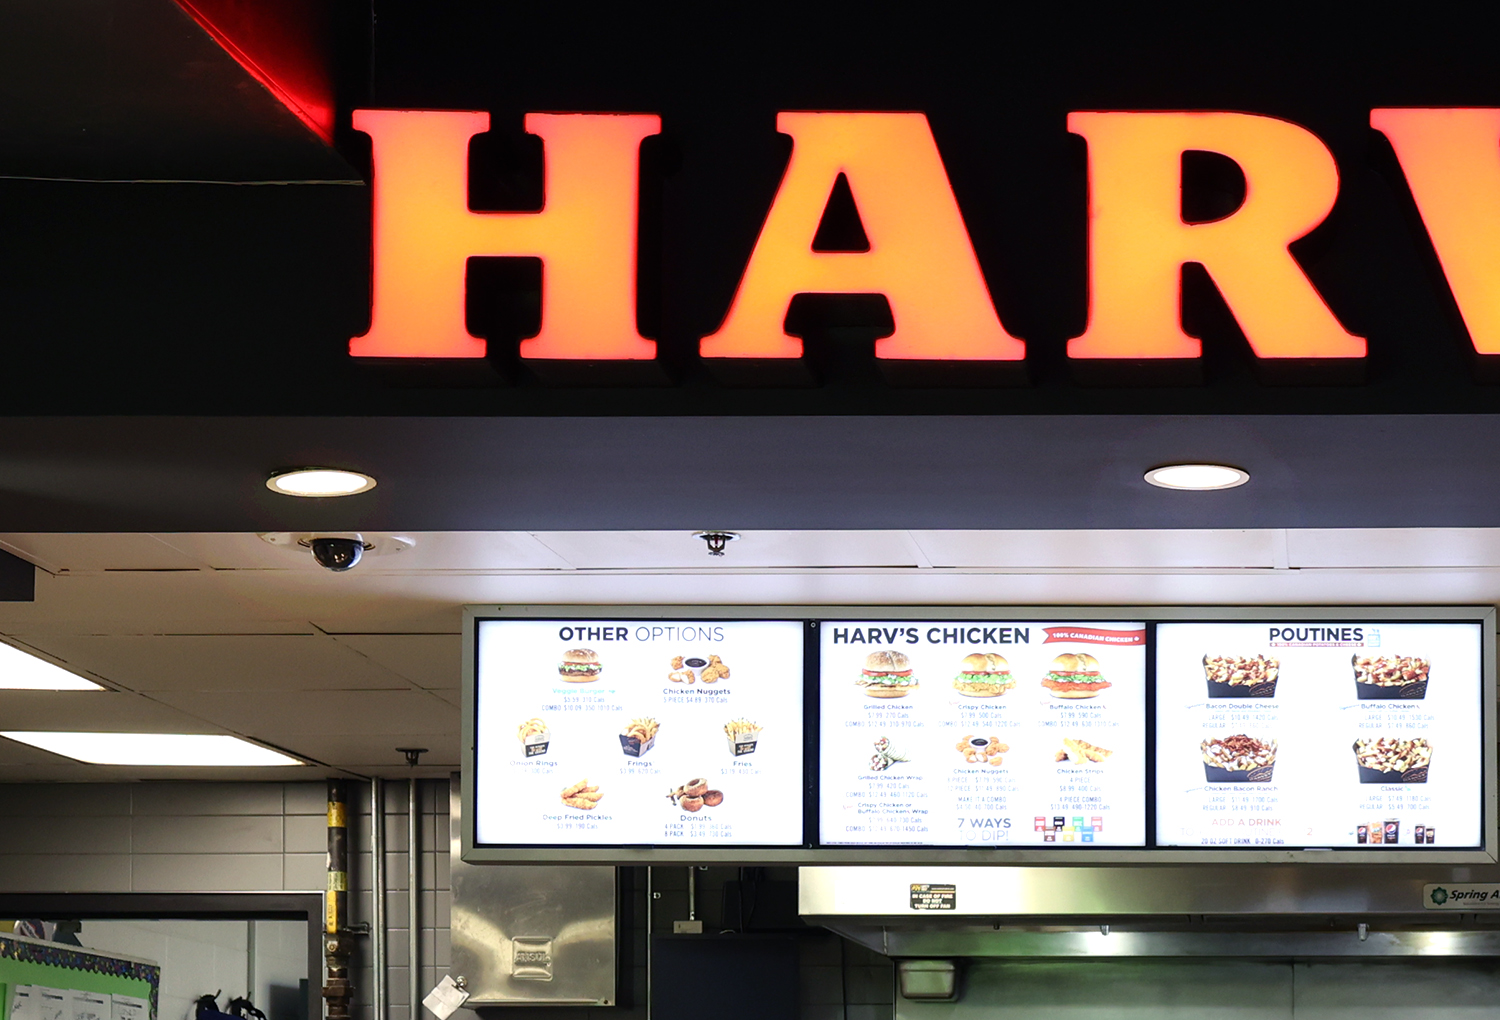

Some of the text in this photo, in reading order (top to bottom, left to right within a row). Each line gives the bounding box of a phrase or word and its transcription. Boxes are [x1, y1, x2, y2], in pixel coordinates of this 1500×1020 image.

[559, 626, 724, 641] OTHER OPTIONS
[833, 627, 1030, 644] HARV'S CHICKEN
[1070, 633, 1104, 642] CANADIAN
[1269, 628, 1363, 641] POUTINES
[958, 818, 1011, 828] 7 WAYS
[1450, 890, 1488, 901] Spring
